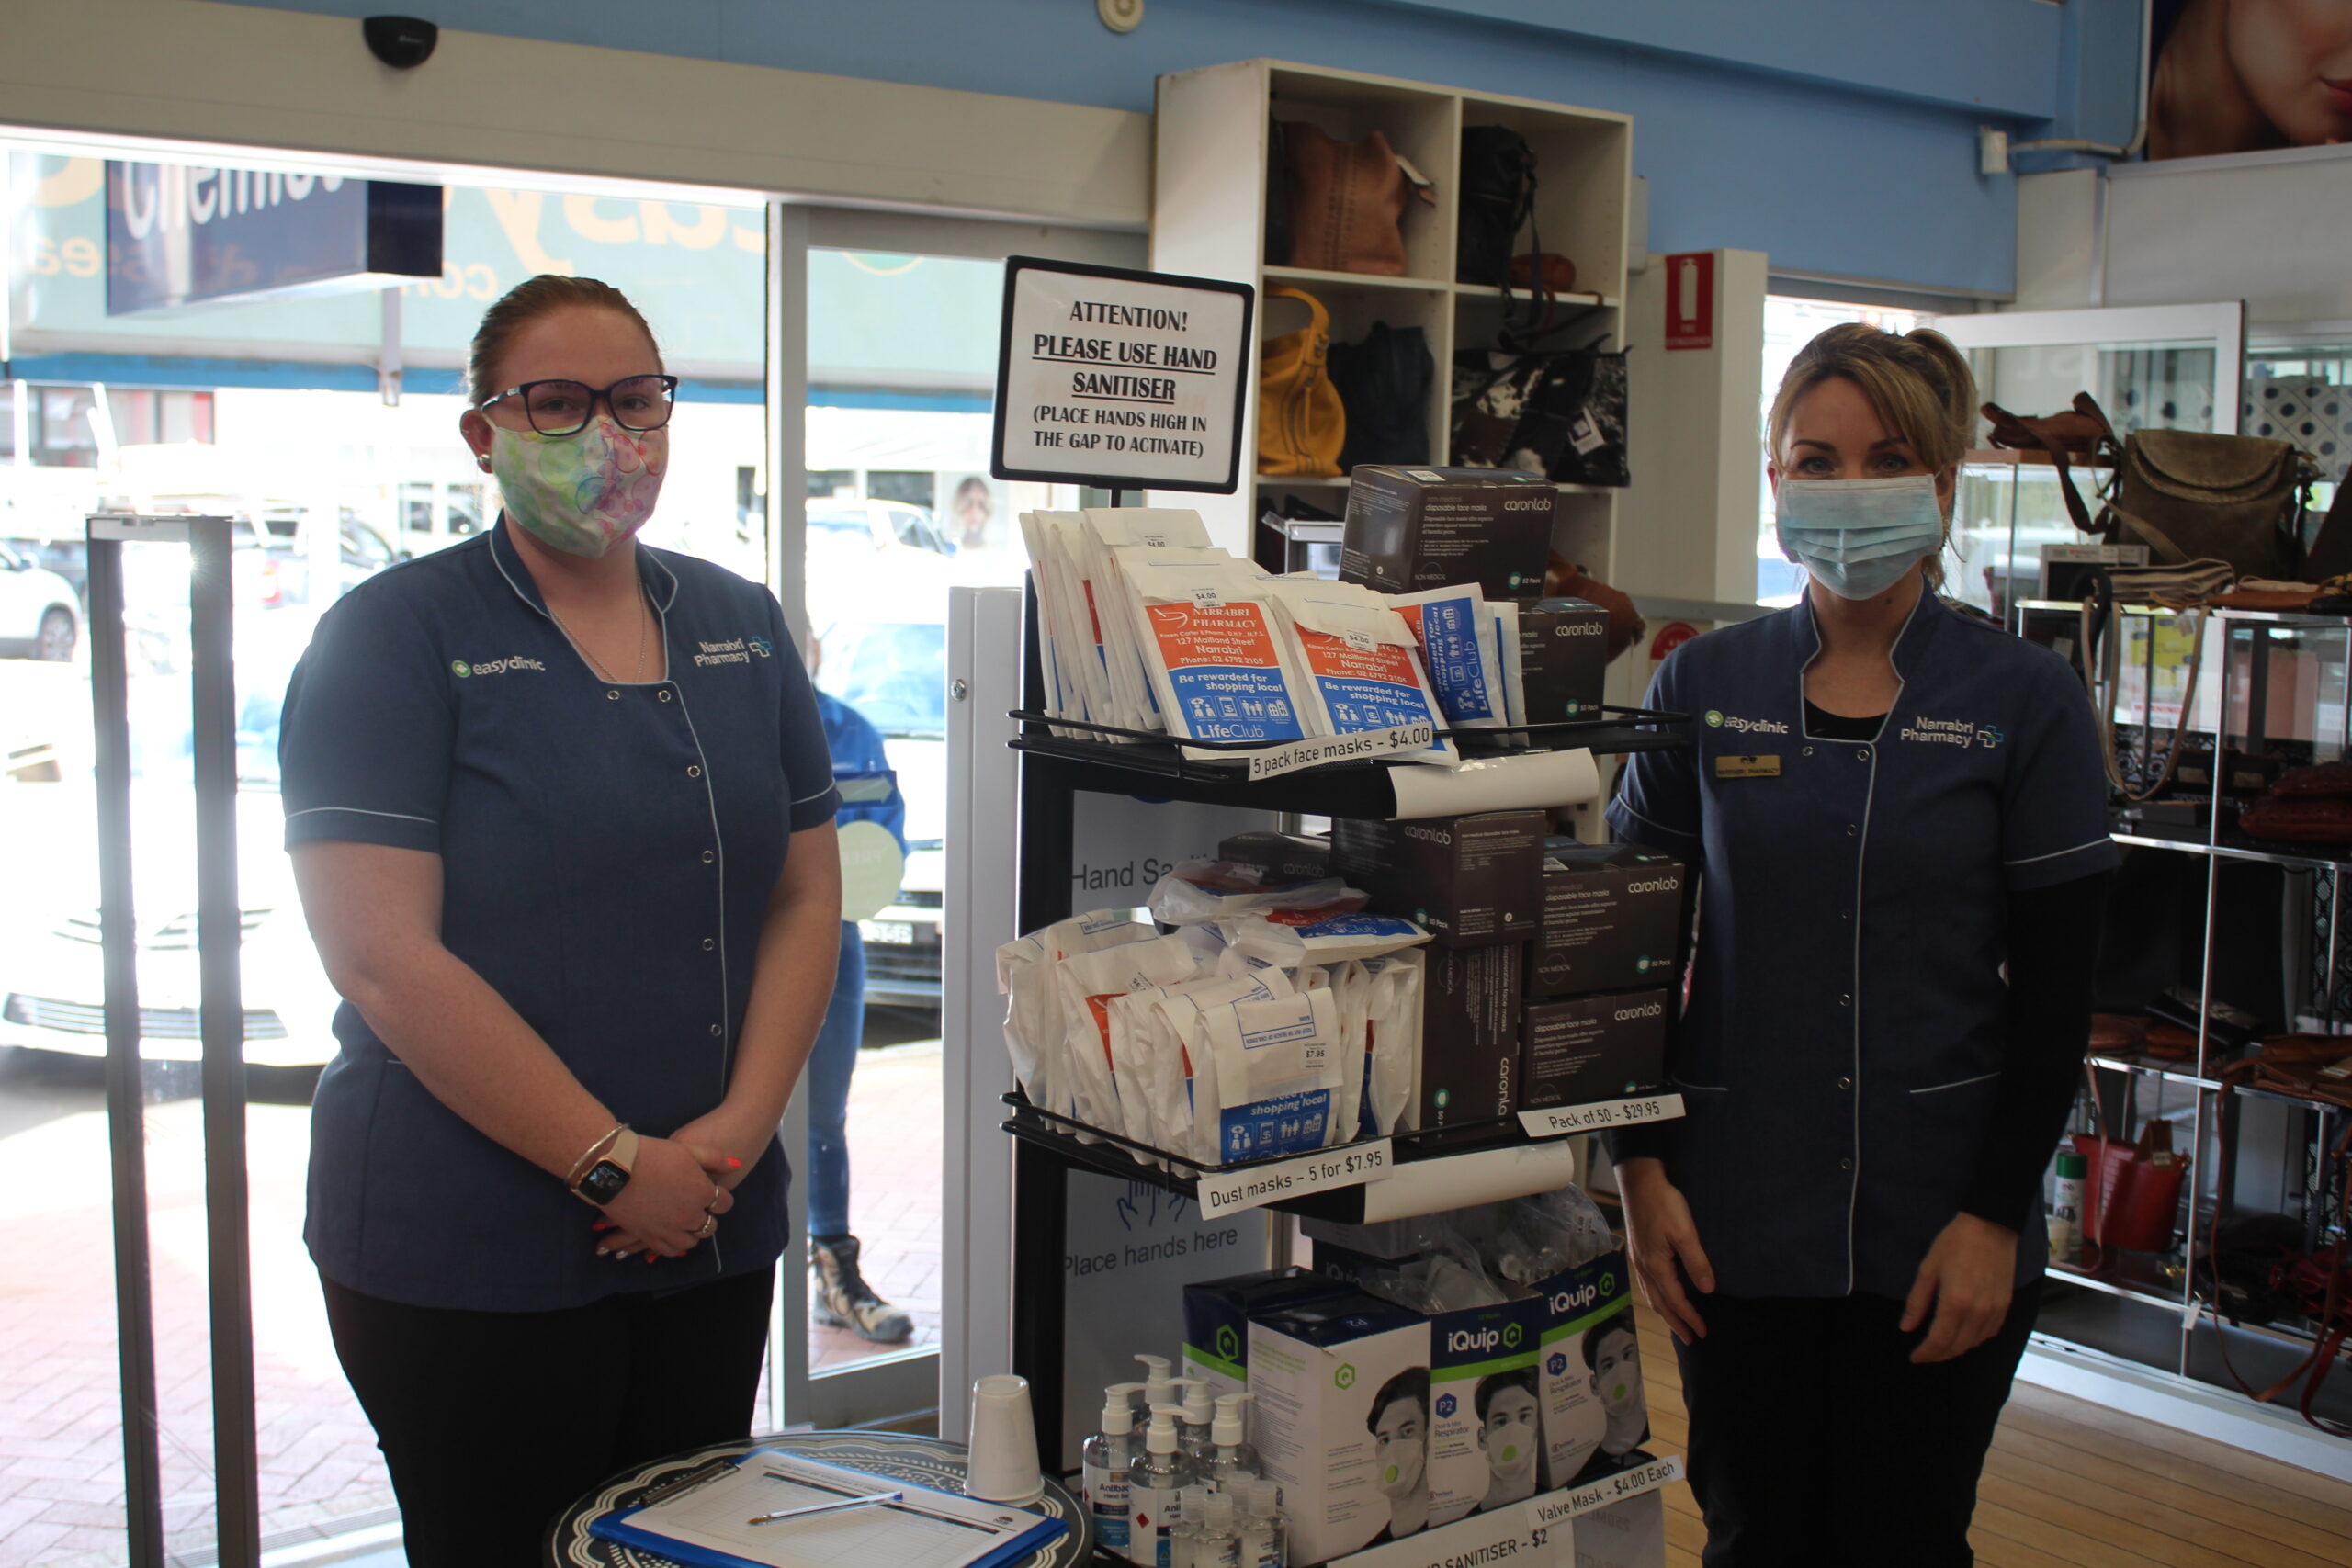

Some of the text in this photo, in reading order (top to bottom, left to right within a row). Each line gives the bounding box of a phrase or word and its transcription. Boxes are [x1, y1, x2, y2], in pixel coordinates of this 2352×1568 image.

[1069, 301, 1188, 332] ATTENTION!
[1033, 334, 1217, 370] PLEASE USE HAND
[1072, 372, 1175, 400] SANITISER
[1034, 405, 1206, 432] (PLACE HANDS HIGH IN
[1034, 430, 1203, 458] THE GAP TO ACTIVATE)
[1504, 497, 1551, 511] caronlab
[1193, 608, 1250, 617] NARRABRI
[1193, 619, 1257, 628] PHARMACY
[1555, 622, 1602, 637] caronlab
[699, 638, 744, 653] Narrabri
[1349, 635, 1370, 644] $4.00
[1431, 606, 1450, 692] shopping local
[694, 649, 751, 668] Pharmacy
[1196, 645, 1242, 655] Narrabri
[1427, 620, 1444, 697] rewarded for
[472, 655, 546, 676] easyclinic
[1224, 656, 1242, 664] 6792
[1244, 657, 1264, 665] 2105
[1340, 660, 1387, 672] Narrabri
[1376, 658, 1399, 667] Street
[1179, 673, 1267, 683] Be rewarded for
[1326, 668, 1355, 676] Phone:
[1369, 671, 1386, 681] 6792
[1387, 674, 1408, 684] 2105
[1464, 641, 1489, 712] LifeClub
[1205, 682, 1283, 693] shopping local
[1324, 682, 1411, 699] Be rewarded for
[1350, 693, 1425, 709] shopping local
[1196, 724, 1265, 739] LifeClub
[1916, 716, 1974, 734] Narrabri
[1900, 728, 1972, 749] Pharmacy
[1253, 759, 1261, 774] 5
[1264, 751, 1291, 776] pack
[1294, 747, 1319, 764] face
[1324, 738, 1373, 758] masks
[1389, 727, 1430, 750] $4.00
[1404, 825, 1452, 845] caronlab
[1072, 861, 1134, 890] Hand
[1627, 877, 1679, 893] caronlab
[1614, 1002, 1662, 1021] caronlab
[1306, 1050, 1325, 1058] $7.95
[1250, 1100, 1299, 1116] shopping
[1302, 1093, 1327, 1106] local
[1548, 1113, 1582, 1129] Pack
[1584, 1111, 1595, 1123] of
[1597, 1108, 1611, 1122] 50
[1623, 1101, 1660, 1120] $29.95
[1210, 1183, 1243, 1207] Dust
[1247, 1175, 1292, 1198] masks
[1308, 1166, 1317, 1181] 5
[1321, 1163, 1341, 1178] for
[1345, 1150, 1383, 1175] $7.95
[1064, 1228, 1238, 1276] Place hands here
[1548, 1284, 1597, 1315] iQuip
[1447, 1327, 1499, 1353] iQuip
[1551, 1358, 1564, 1371] P2
[1440, 1400, 1453, 1412] P2
[1434, 1426, 1470, 1438] Respirator
[1537, 1502, 1570, 1522] Valve
[1572, 1487, 1604, 1510] Mask
[1613, 1472, 1645, 1495] $4.00
[1647, 1462, 1675, 1483] Each
[1444, 1539, 1517, 1568] SANITISER
[1532, 1529, 1548, 1549] $2
